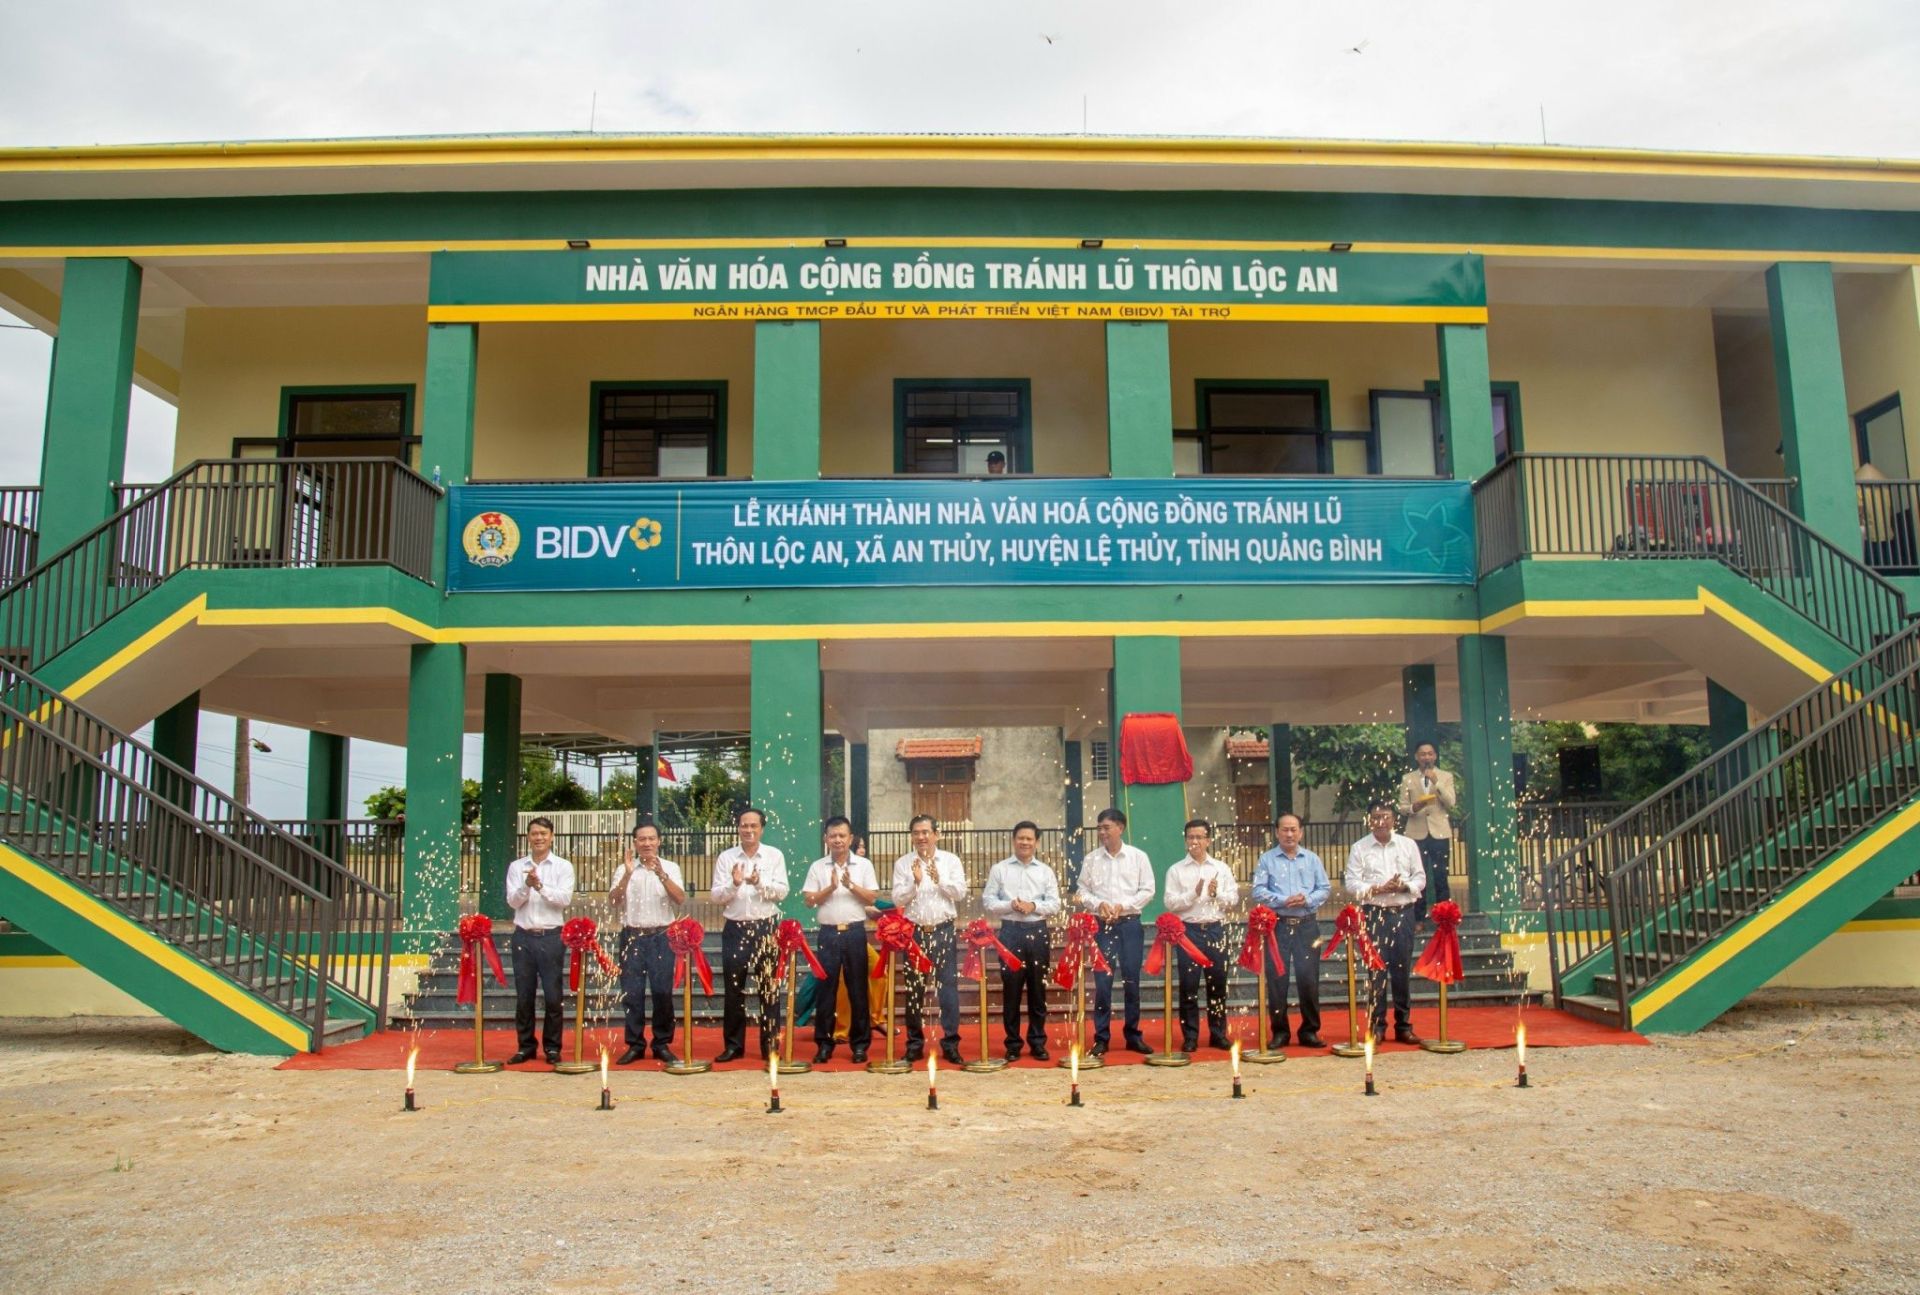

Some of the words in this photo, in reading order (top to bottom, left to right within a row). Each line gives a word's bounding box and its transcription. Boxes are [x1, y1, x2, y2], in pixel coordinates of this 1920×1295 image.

[586, 258, 648, 291] NHÀ
[658, 257, 717, 291] VĂN
[728, 255, 789, 290] HÓA
[799, 256, 882, 296] CỘNG
[892, 250, 975, 290] ĐỒNG
[985, 257, 1087, 291] TRÁNH
[1098, 257, 1134, 291] LŨ
[1144, 258, 1223, 292] THÔN
[1232, 259, 1287, 299] LỘC
[1296, 266, 1338, 293] AN
[693, 304, 738, 317] NGÂN
[744, 304, 788, 316] HÀNG
[796, 306, 839, 315] TMCP
[845, 302, 877, 316] ĐẦU
[885, 304, 906, 315] TƯ
[912, 304, 930, 315] VÀ
[938, 304, 977, 315] PHÁT
[985, 301, 1030, 316] TRIỂN
[1037, 304, 1070, 318] VIỆT
[1077, 306, 1112, 316] NAM
[1119, 306, 1164, 317] (BIDV)
[1171, 305, 1193, 317] TÀI
[1200, 306, 1231, 319] TRỢ
[734, 497, 760, 527] LỄ
[766, 499, 846, 527] KHÁNH
[852, 497, 931, 526] THÀNH
[937, 497, 986, 525] NHÀ
[991, 496, 1037, 525] VĂN
[1043, 496, 1091, 525] HOÁ
[1096, 496, 1159, 530] CỘNG
[1164, 494, 1228, 525] ĐỒNG
[1233, 496, 1308, 525] TRÁNH
[1314, 496, 1342, 525] LŨ
[536, 525, 630, 559] BIDV
[692, 536, 755, 565] THÔN
[761, 535, 805, 569] LỘC
[811, 541, 849, 568] AN,
[855, 534, 886, 564] XÃ
[892, 540, 923, 563] AN
[929, 532, 995, 567] THỦY,
[1001, 533, 1079, 567] HUYỆN
[1085, 533, 1112, 567] LỆ
[1117, 532, 1181, 567] THỦY,
[1187, 531, 1240, 562] TỈNH
[1246, 531, 1323, 564] QUẢNG
[1329, 534, 1382, 562] BÌNH
